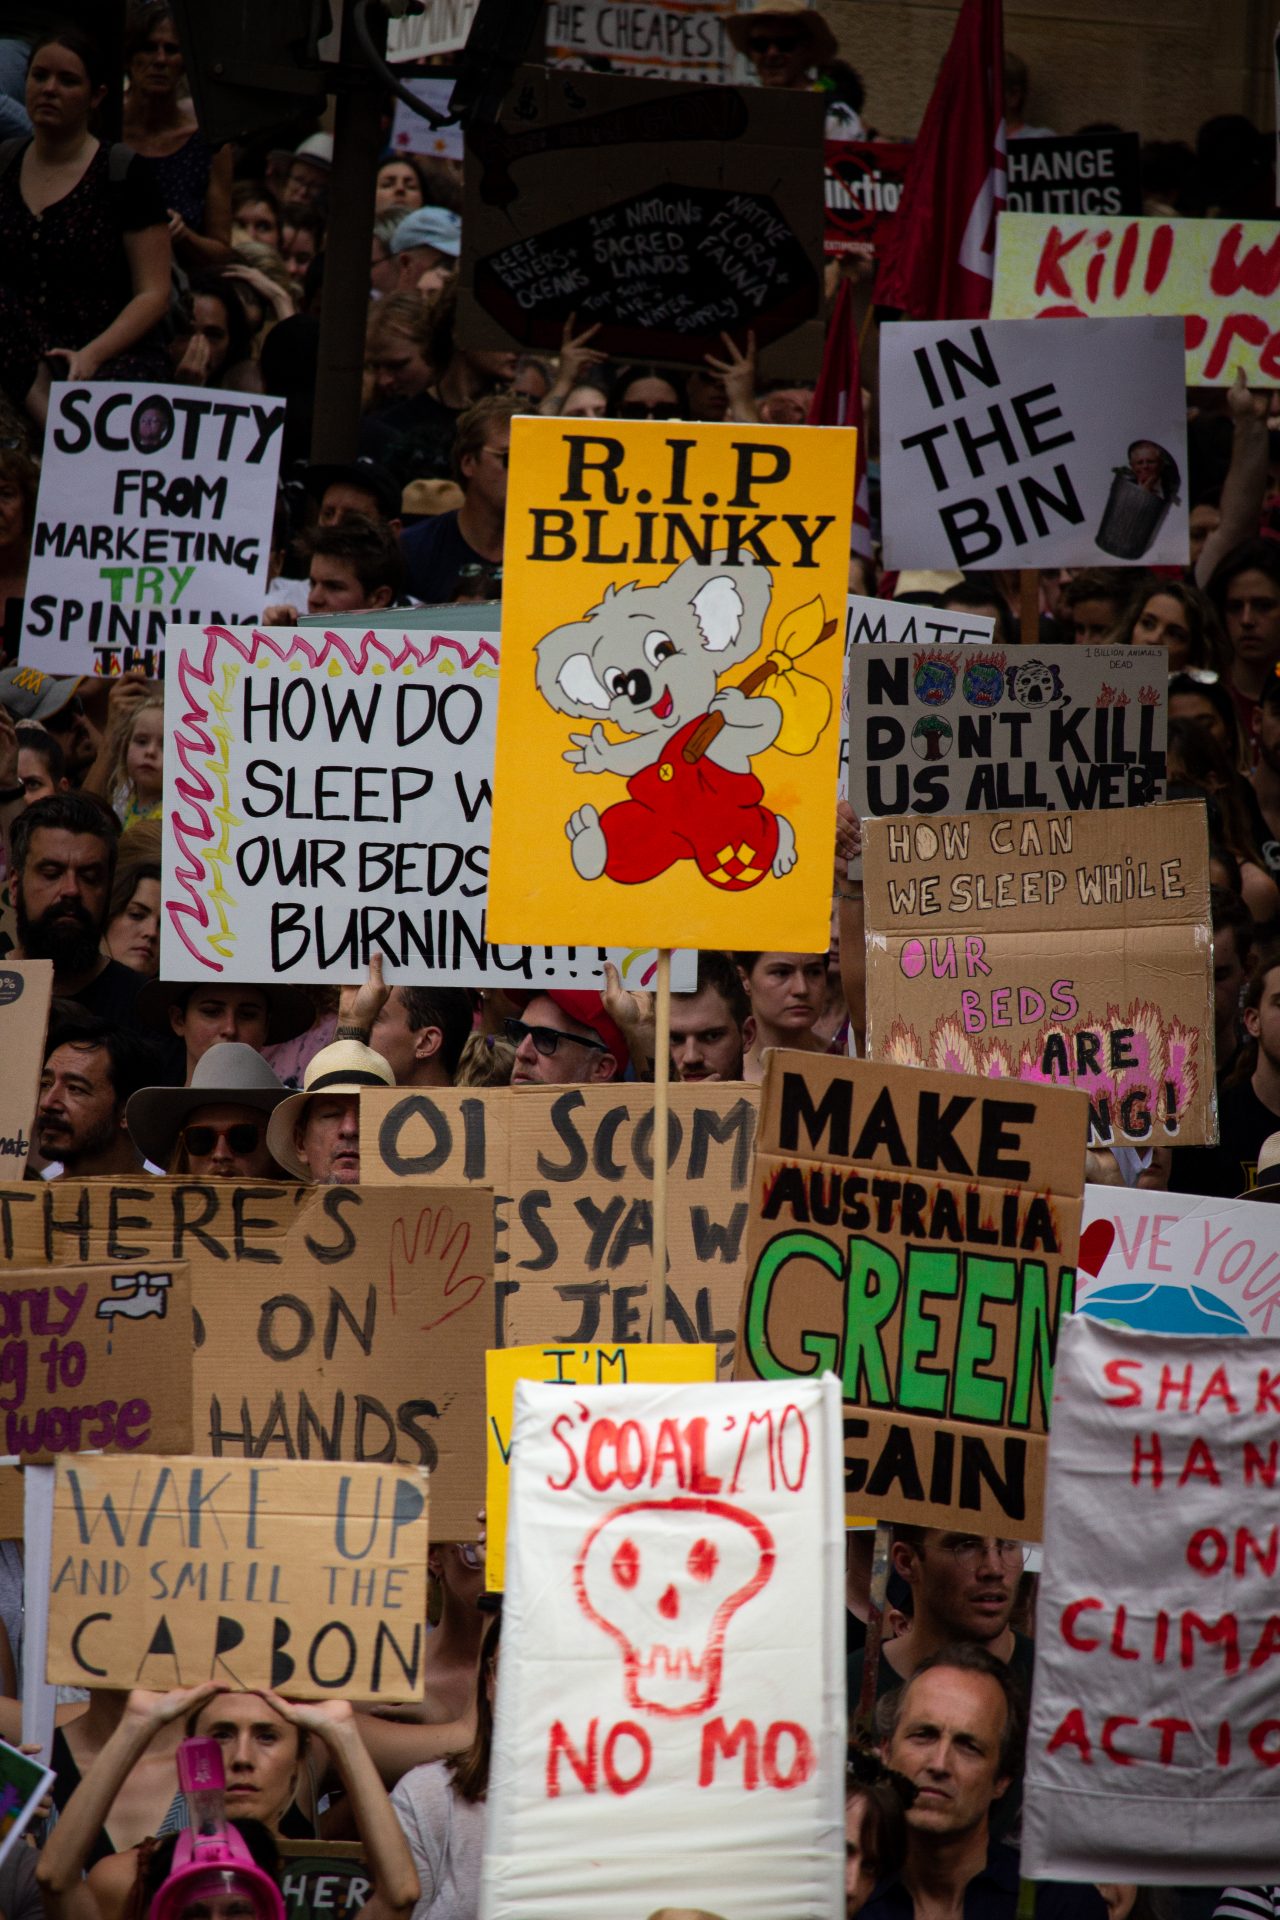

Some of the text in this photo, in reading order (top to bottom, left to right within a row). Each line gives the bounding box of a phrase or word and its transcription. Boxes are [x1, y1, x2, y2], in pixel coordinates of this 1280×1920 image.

[597, 7, 726, 60] CHEAPEST
[1007, 148, 1115, 183] HANGE
[591, 230, 685, 264] SACRED
[610, 253, 691, 280] LANDS
[1034, 221, 1174, 304] Kill
[912, 325, 1002, 409] IN
[53, 388, 286, 464] SCOTTY
[899, 383, 1076, 492] THE
[113, 469, 228, 520] FROM
[559, 434, 792, 508] R.I.P
[526, 507, 837, 568] BLINKY
[938, 463, 1086, 568] BIN
[34, 521, 260, 575] MARKETING
[99, 565, 197, 605] TRY
[1093, 647, 1124, 657] BILLION
[1109, 660, 1133, 669] DEAD
[242, 676, 483, 747] HOW DO
[1048, 704, 1166, 764] KILL
[241, 759, 434, 824] SLEEP
[866, 763, 950, 816] US
[236, 835, 490, 898] OUR BEDS
[887, 816, 1073, 864] HOW CAN
[887, 875, 942, 917] WE
[948, 869, 1068, 913] SLEEP
[900, 936, 993, 980] OUR
[960, 979, 1079, 1034] BEDS
[1041, 1028, 1140, 1077] ARE
[378, 1094, 486, 1181] OI
[778, 1072, 1037, 1182] MAKE
[0, 1186, 363, 1265] THERE'S
[761, 1164, 1062, 1254] AUSTRALIA
[258, 1283, 377, 1362] ON
[744, 1228, 1078, 1435] GREEN
[41, 1337, 87, 1393] to
[543, 1348, 628, 1385] I'M
[6, 1399, 152, 1454] worse
[209, 1387, 442, 1472] HANDS
[844, 1418, 1027, 1521] GAIN
[1131, 1431, 1278, 1489] HAN
[66, 1467, 425, 1560] WAKE UP
[51, 1555, 410, 1609] AND SMELL THE
[1187, 1526, 1280, 1580] ON
[71, 1611, 421, 1693] CARBON
[547, 1716, 818, 1798] NO MO
